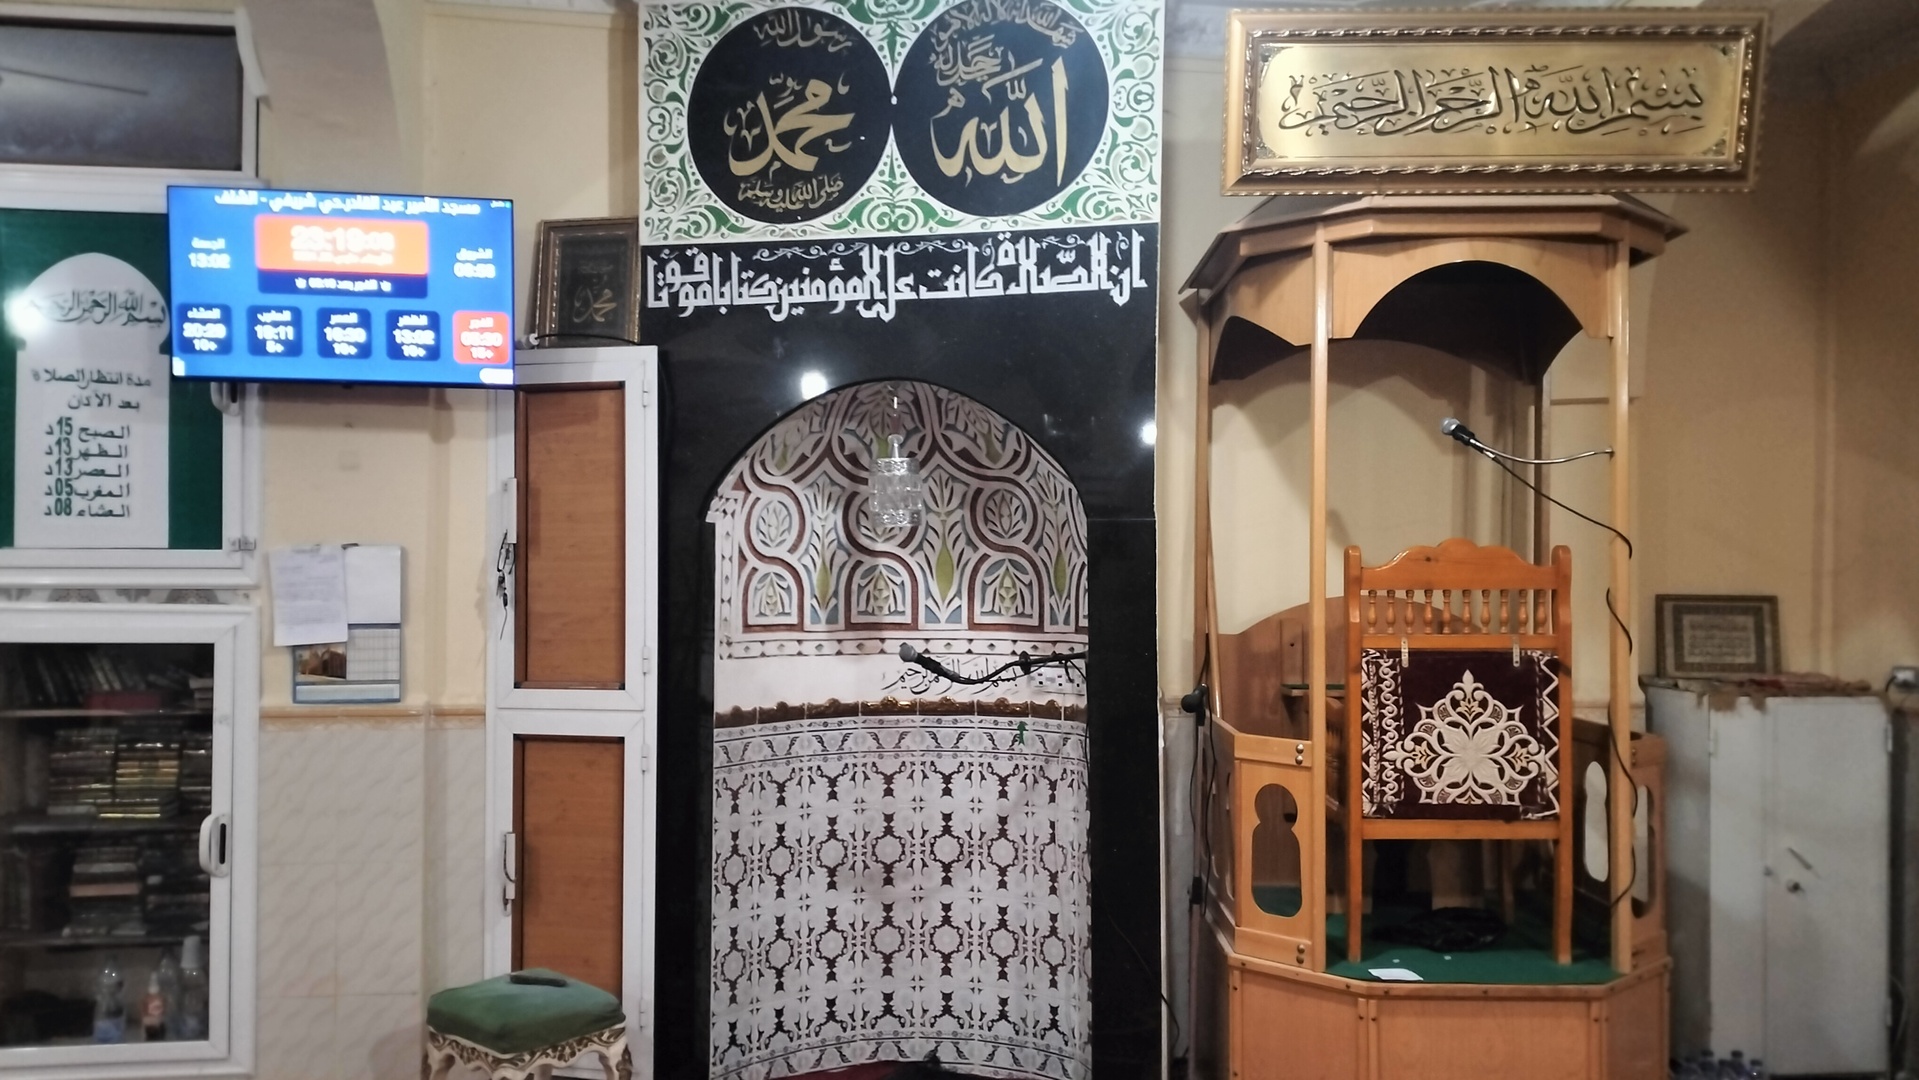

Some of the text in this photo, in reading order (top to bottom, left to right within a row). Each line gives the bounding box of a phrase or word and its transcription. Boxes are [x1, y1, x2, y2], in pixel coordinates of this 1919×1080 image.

[1522, 66, 1615, 120] الله
[727, 78, 856, 177] محمد
[930, 57, 1069, 187] الله
[56, 416, 73, 437] 15
[78, 424, 130, 442] الصبح
[54, 437, 72, 457] 13
[70, 443, 128, 462] الظهر
[55, 457, 73, 477] 13
[68, 463, 129, 481] العصر
[55, 477, 73, 497] 05
[74, 482, 129, 502] المغرب
[54, 497, 72, 517] 08
[77, 503, 130, 518] العشاء
